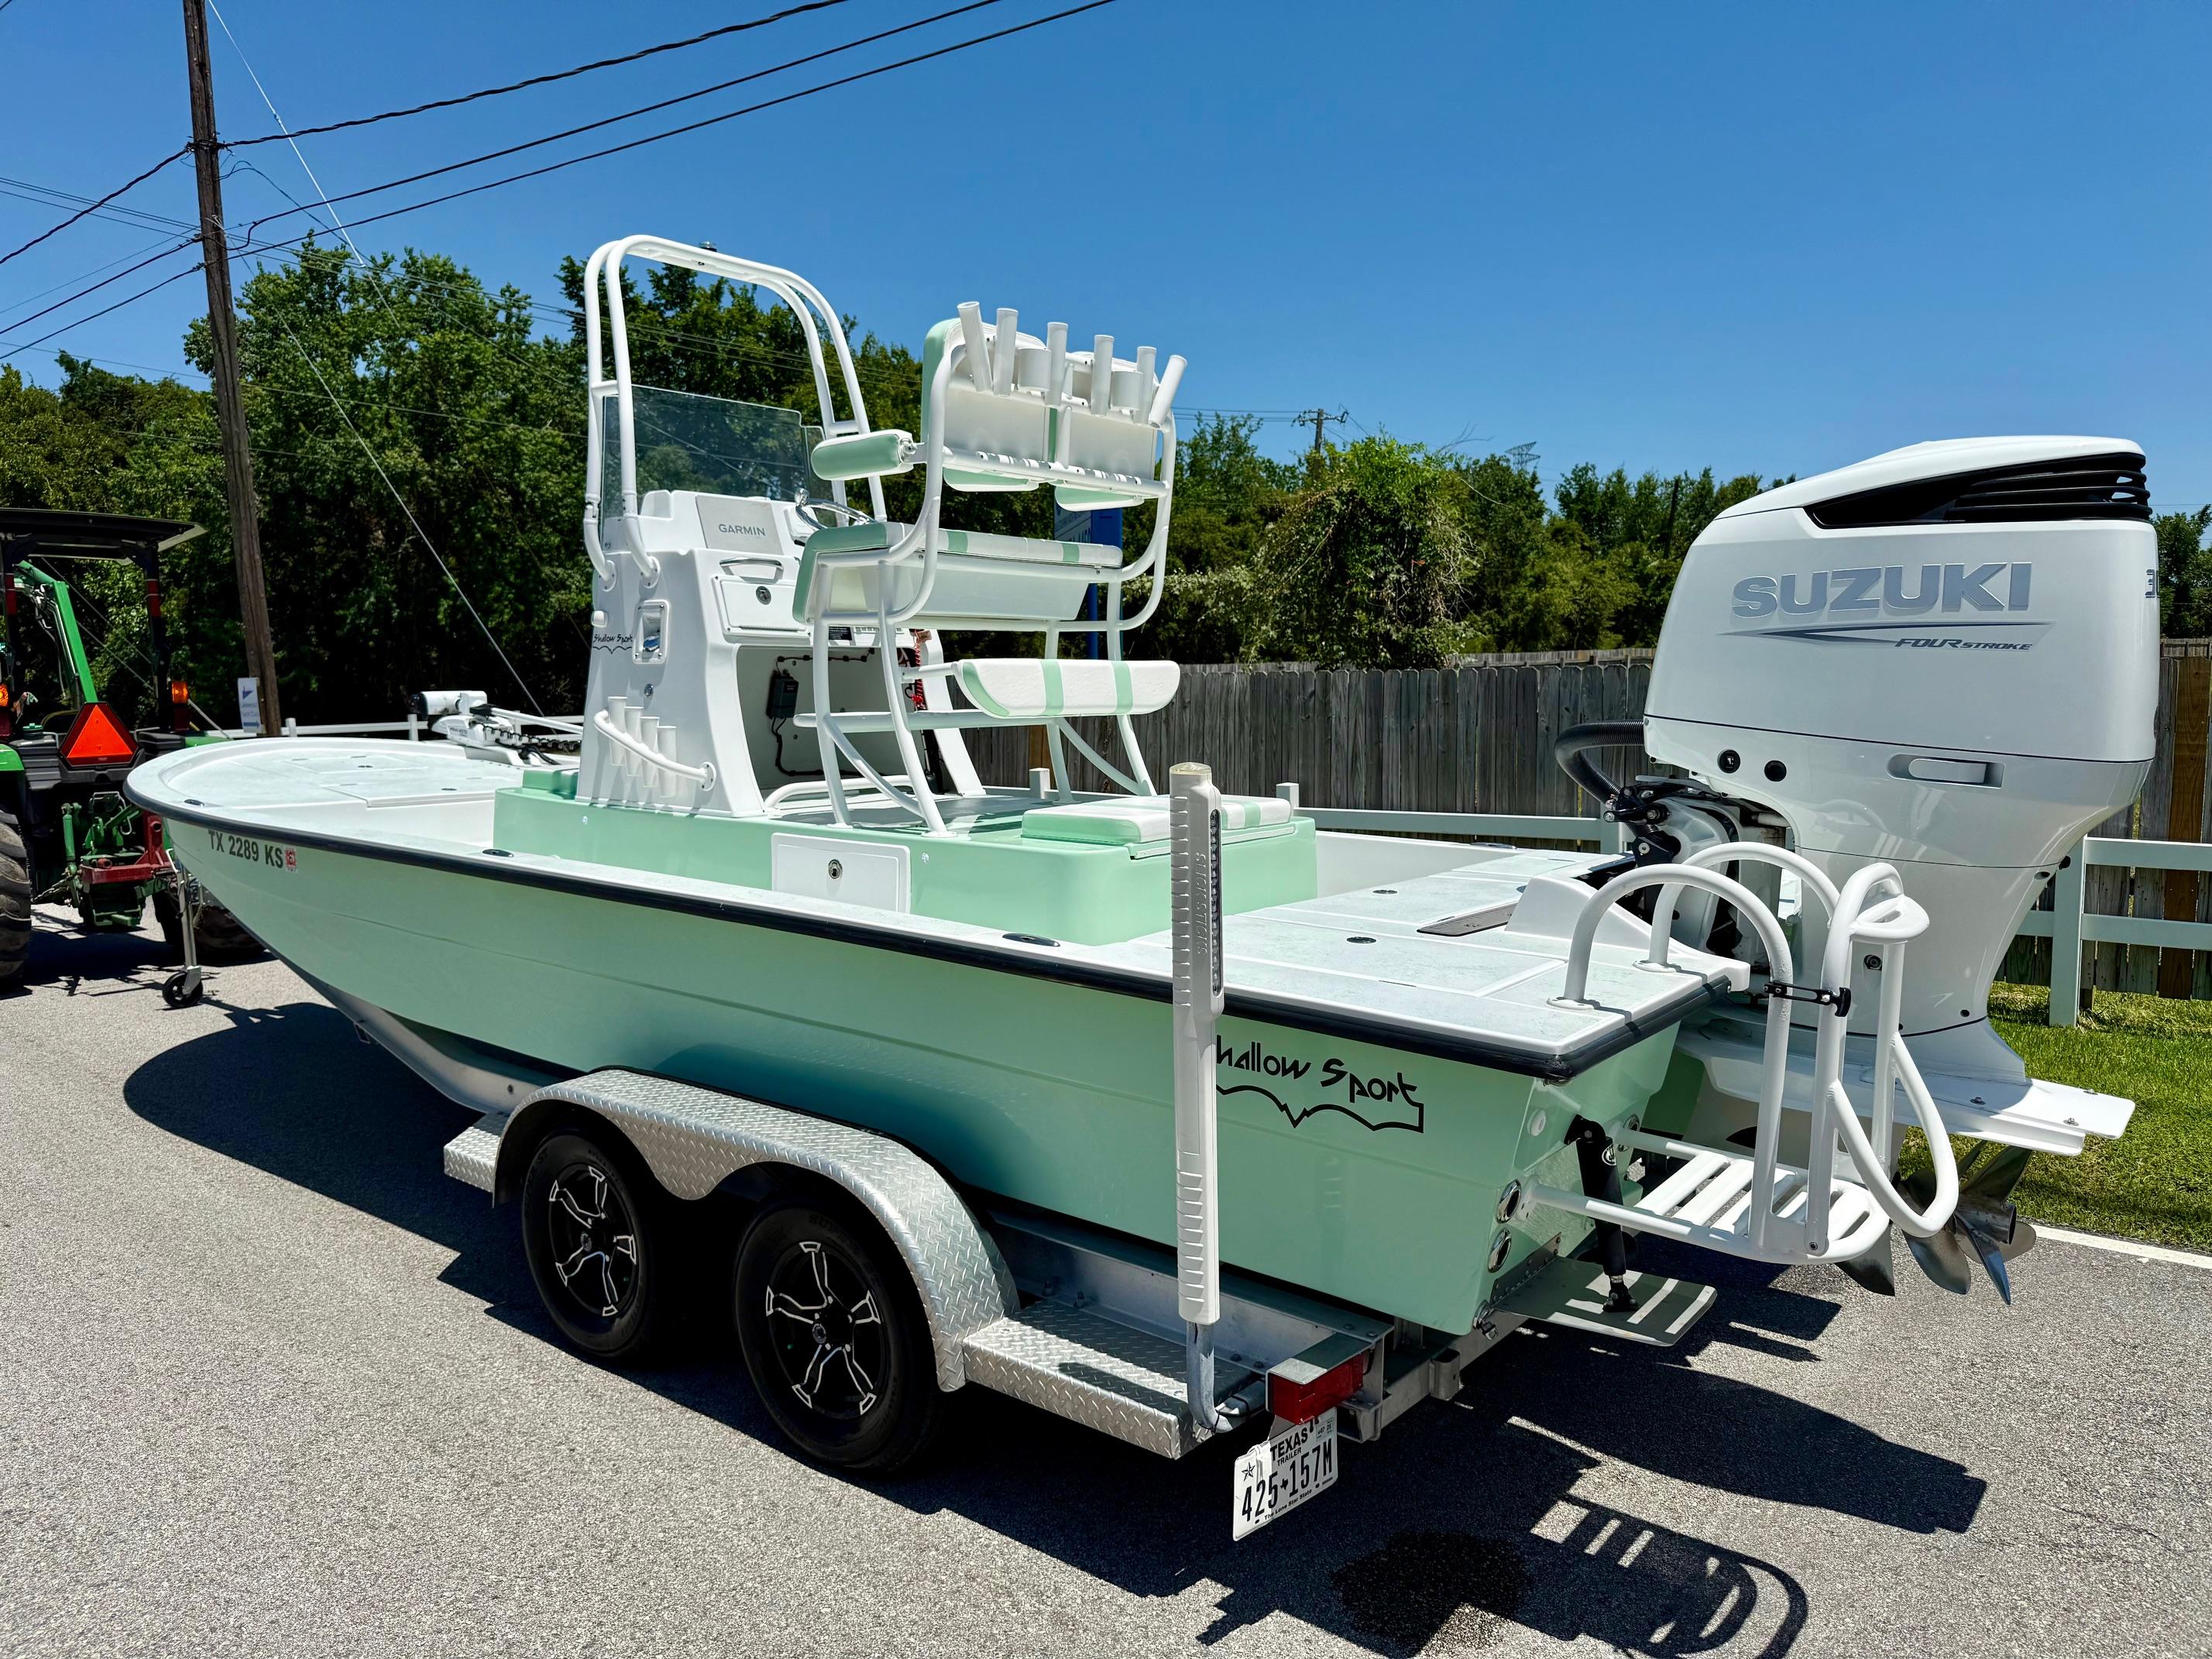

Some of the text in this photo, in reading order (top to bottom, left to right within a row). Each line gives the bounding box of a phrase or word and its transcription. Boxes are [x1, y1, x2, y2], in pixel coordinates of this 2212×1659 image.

[719, 524, 766, 536] GARMIN
[1732, 562, 2032, 618] SUZUKI
[617, 634, 633, 644] Sport
[208, 830, 283, 868] TX 2289 KS
[1217, 1035, 1418, 1104] hallow Sport
[1270, 1427, 1308, 1462] TEXAS
[1277, 1447, 1302, 1467] TRAILER
[1264, 1489, 1313, 1520] The Lone Star State
